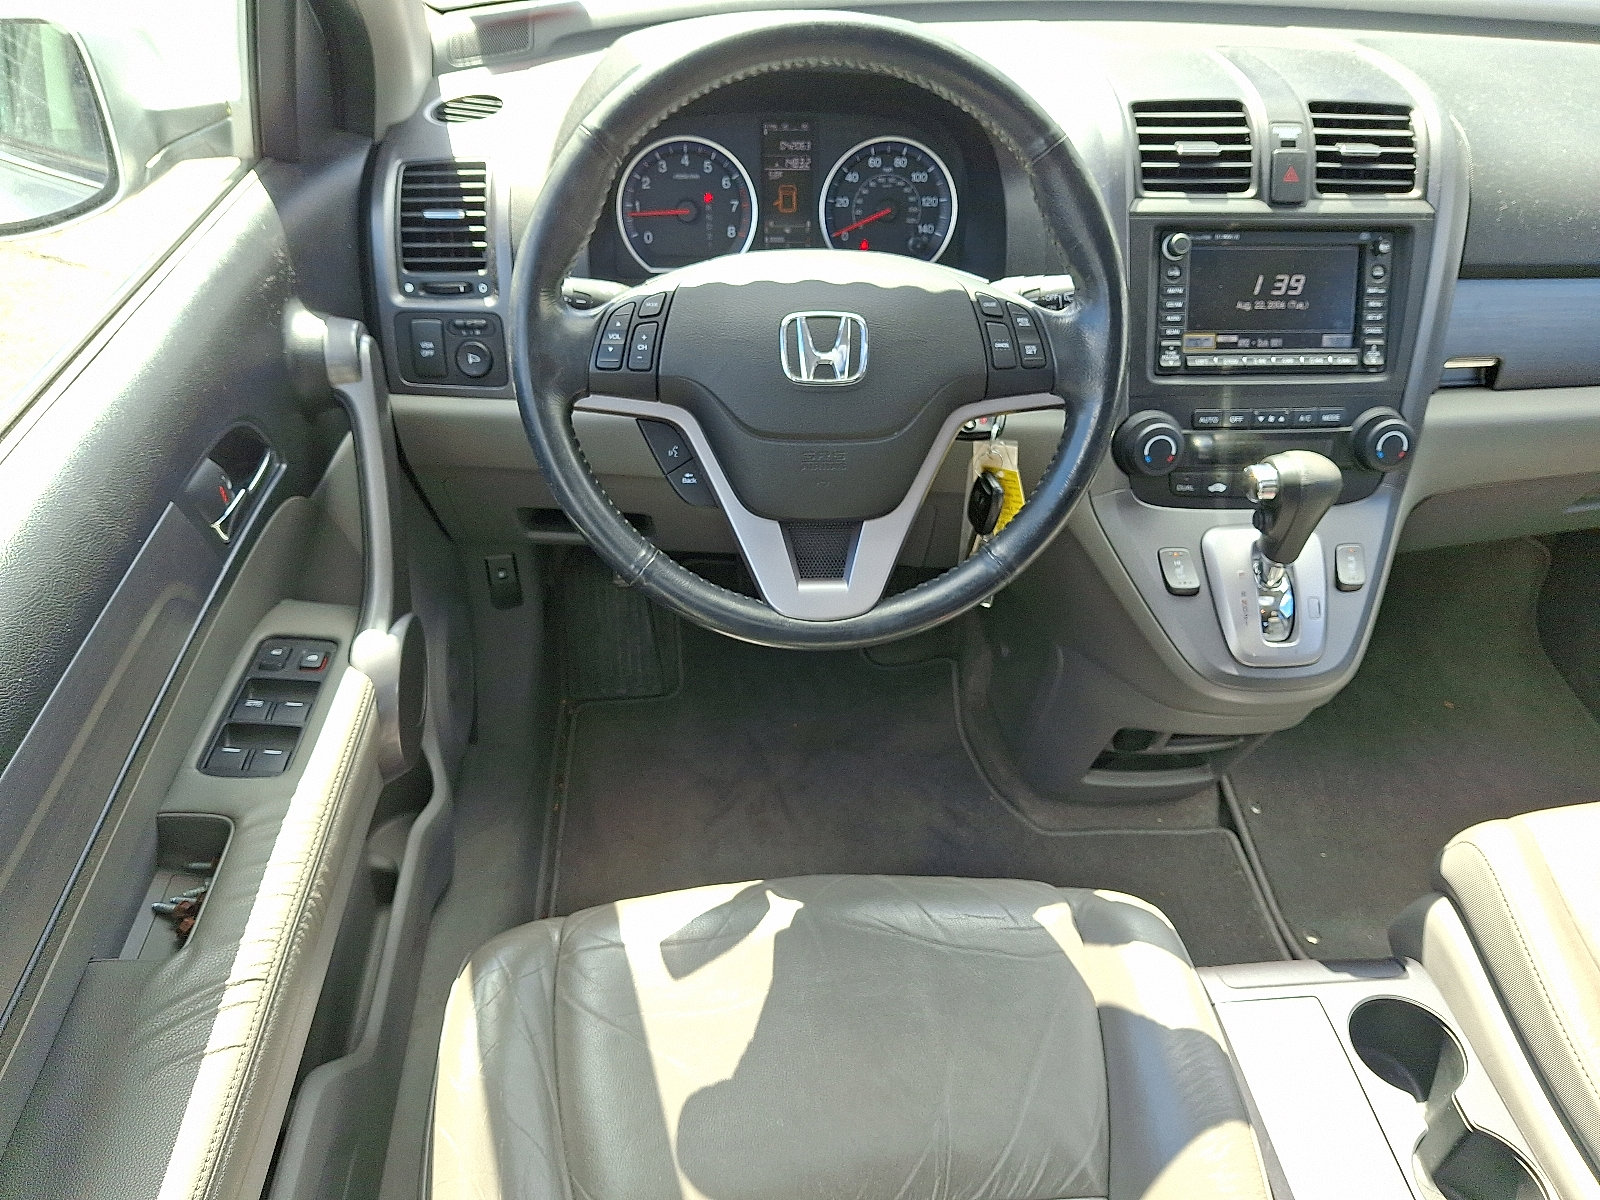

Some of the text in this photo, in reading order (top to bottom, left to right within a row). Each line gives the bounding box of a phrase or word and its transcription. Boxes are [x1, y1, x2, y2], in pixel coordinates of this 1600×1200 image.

[657, 159, 668, 173] 3
[680, 154, 690, 167] 4
[703, 159, 713, 174] 5
[868, 156, 882, 168] 60
[893, 156, 907, 168] 80
[641, 175, 651, 190] 2
[721, 175, 731, 189] 6
[845, 171, 859, 183] 40
[911, 171, 928, 183] 100
[730, 199, 739, 213] 7
[835, 196, 850, 208] 20
[921, 196, 939, 207] 120
[727, 224, 737, 238] 8
[918, 224, 935, 234] 140
[643, 230, 653, 244] 0
[841, 231, 849, 241] 0
[1198, 416, 1219, 424] AUTO
[1321, 414, 1340, 422] MODE
